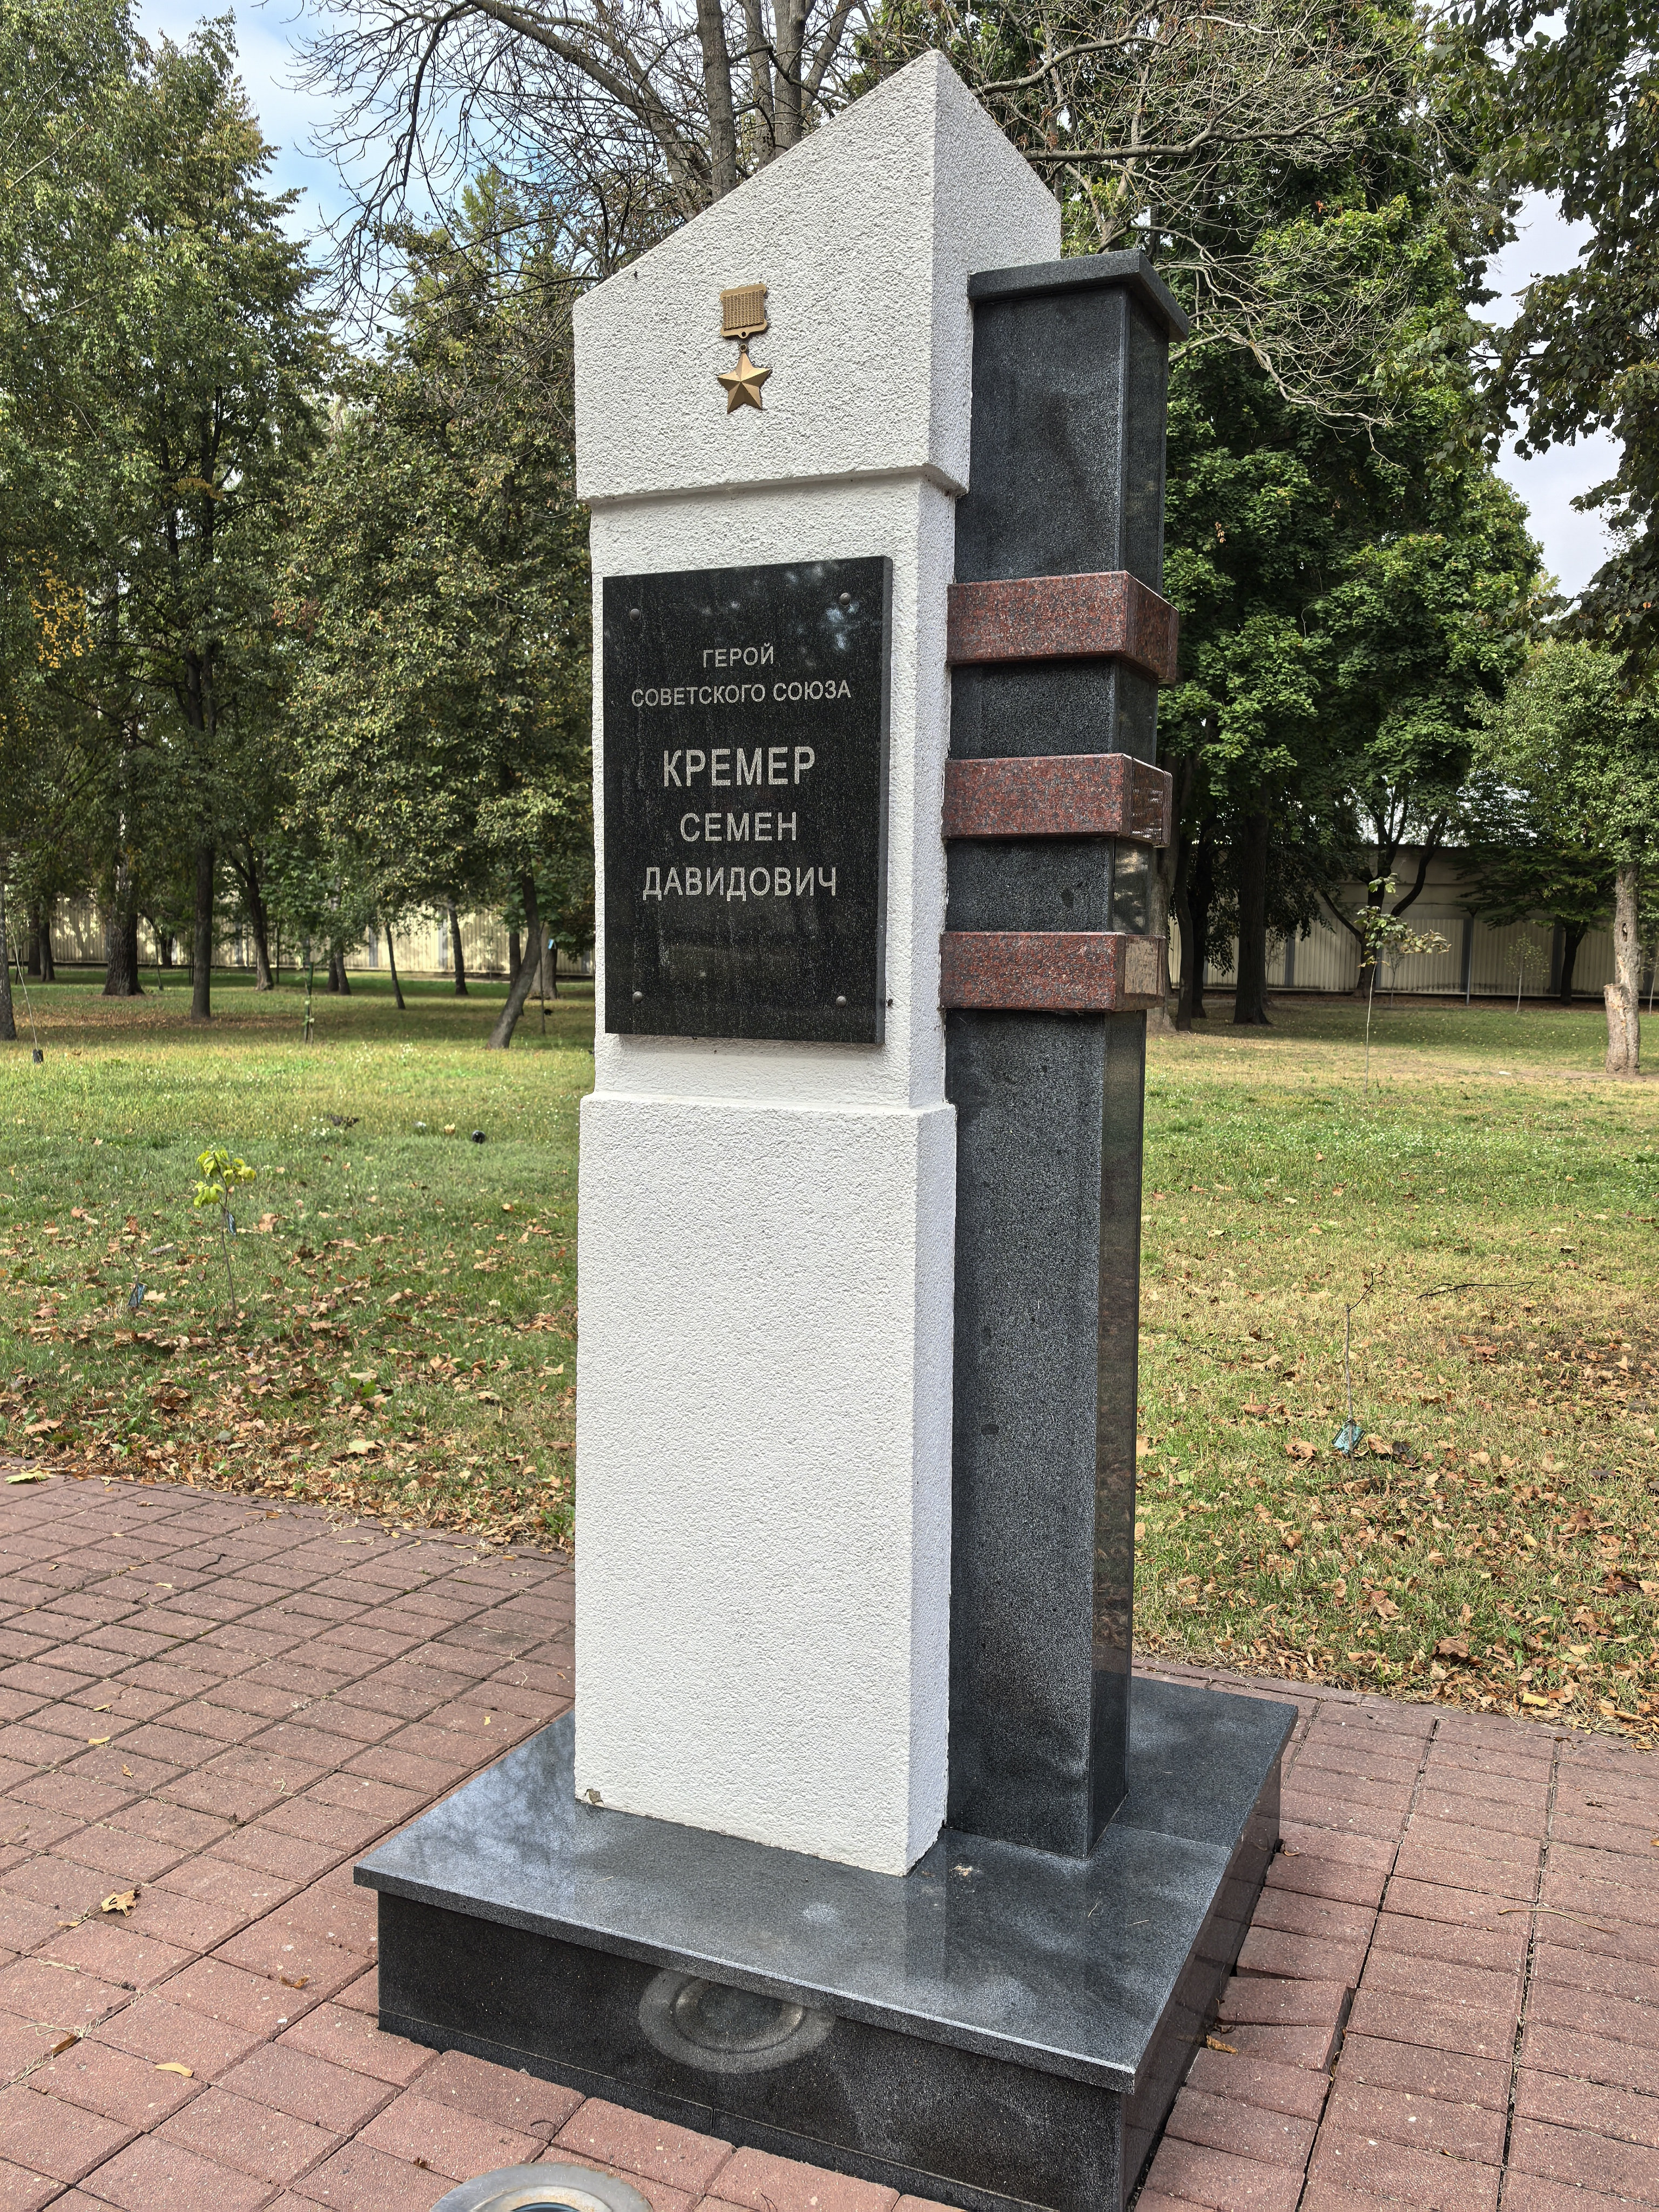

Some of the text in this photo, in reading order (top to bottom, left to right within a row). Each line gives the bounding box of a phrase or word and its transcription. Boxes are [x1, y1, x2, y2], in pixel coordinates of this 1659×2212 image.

[703, 643, 774, 667] ГЕРОЙ
[632, 680, 852, 707] СОВЕТСКОГО СОЮЗА
[663, 746, 815, 787] КРЕМЕР
[680, 812, 797, 841] СЕМЕН
[643, 867, 837, 902] ДАВИДОВИЧ
